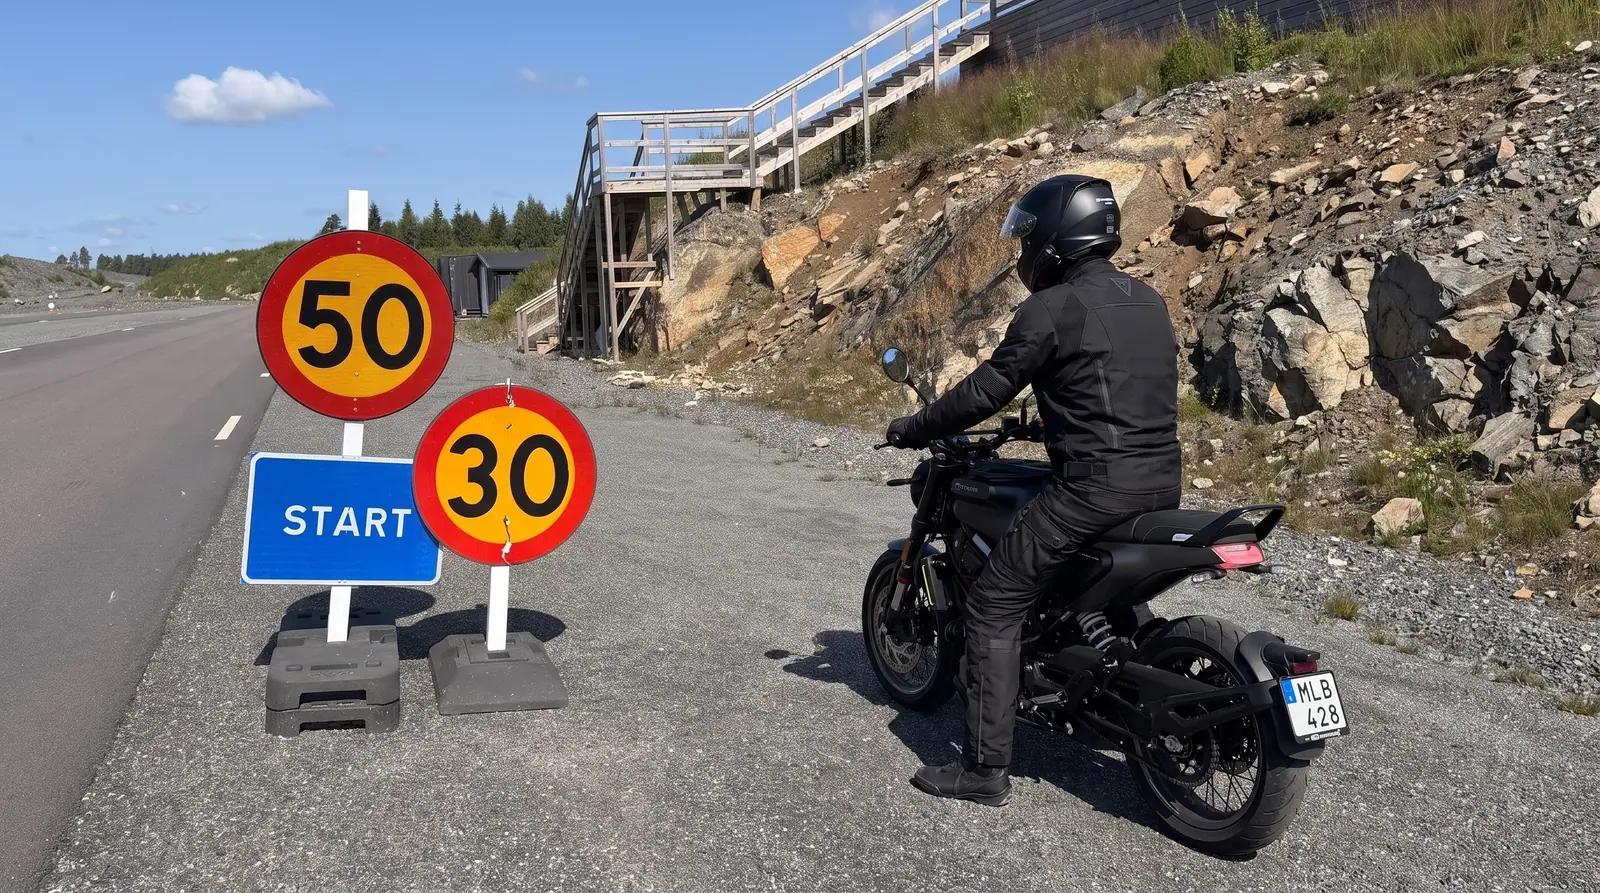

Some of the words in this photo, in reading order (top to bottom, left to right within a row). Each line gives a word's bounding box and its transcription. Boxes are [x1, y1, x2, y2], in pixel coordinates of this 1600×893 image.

[298, 280, 424, 370] 50
[448, 434, 569, 517] 30
[283, 505, 411, 537] START
[1297, 679, 1332, 703] MLB
[1308, 704, 1339, 728] 428
